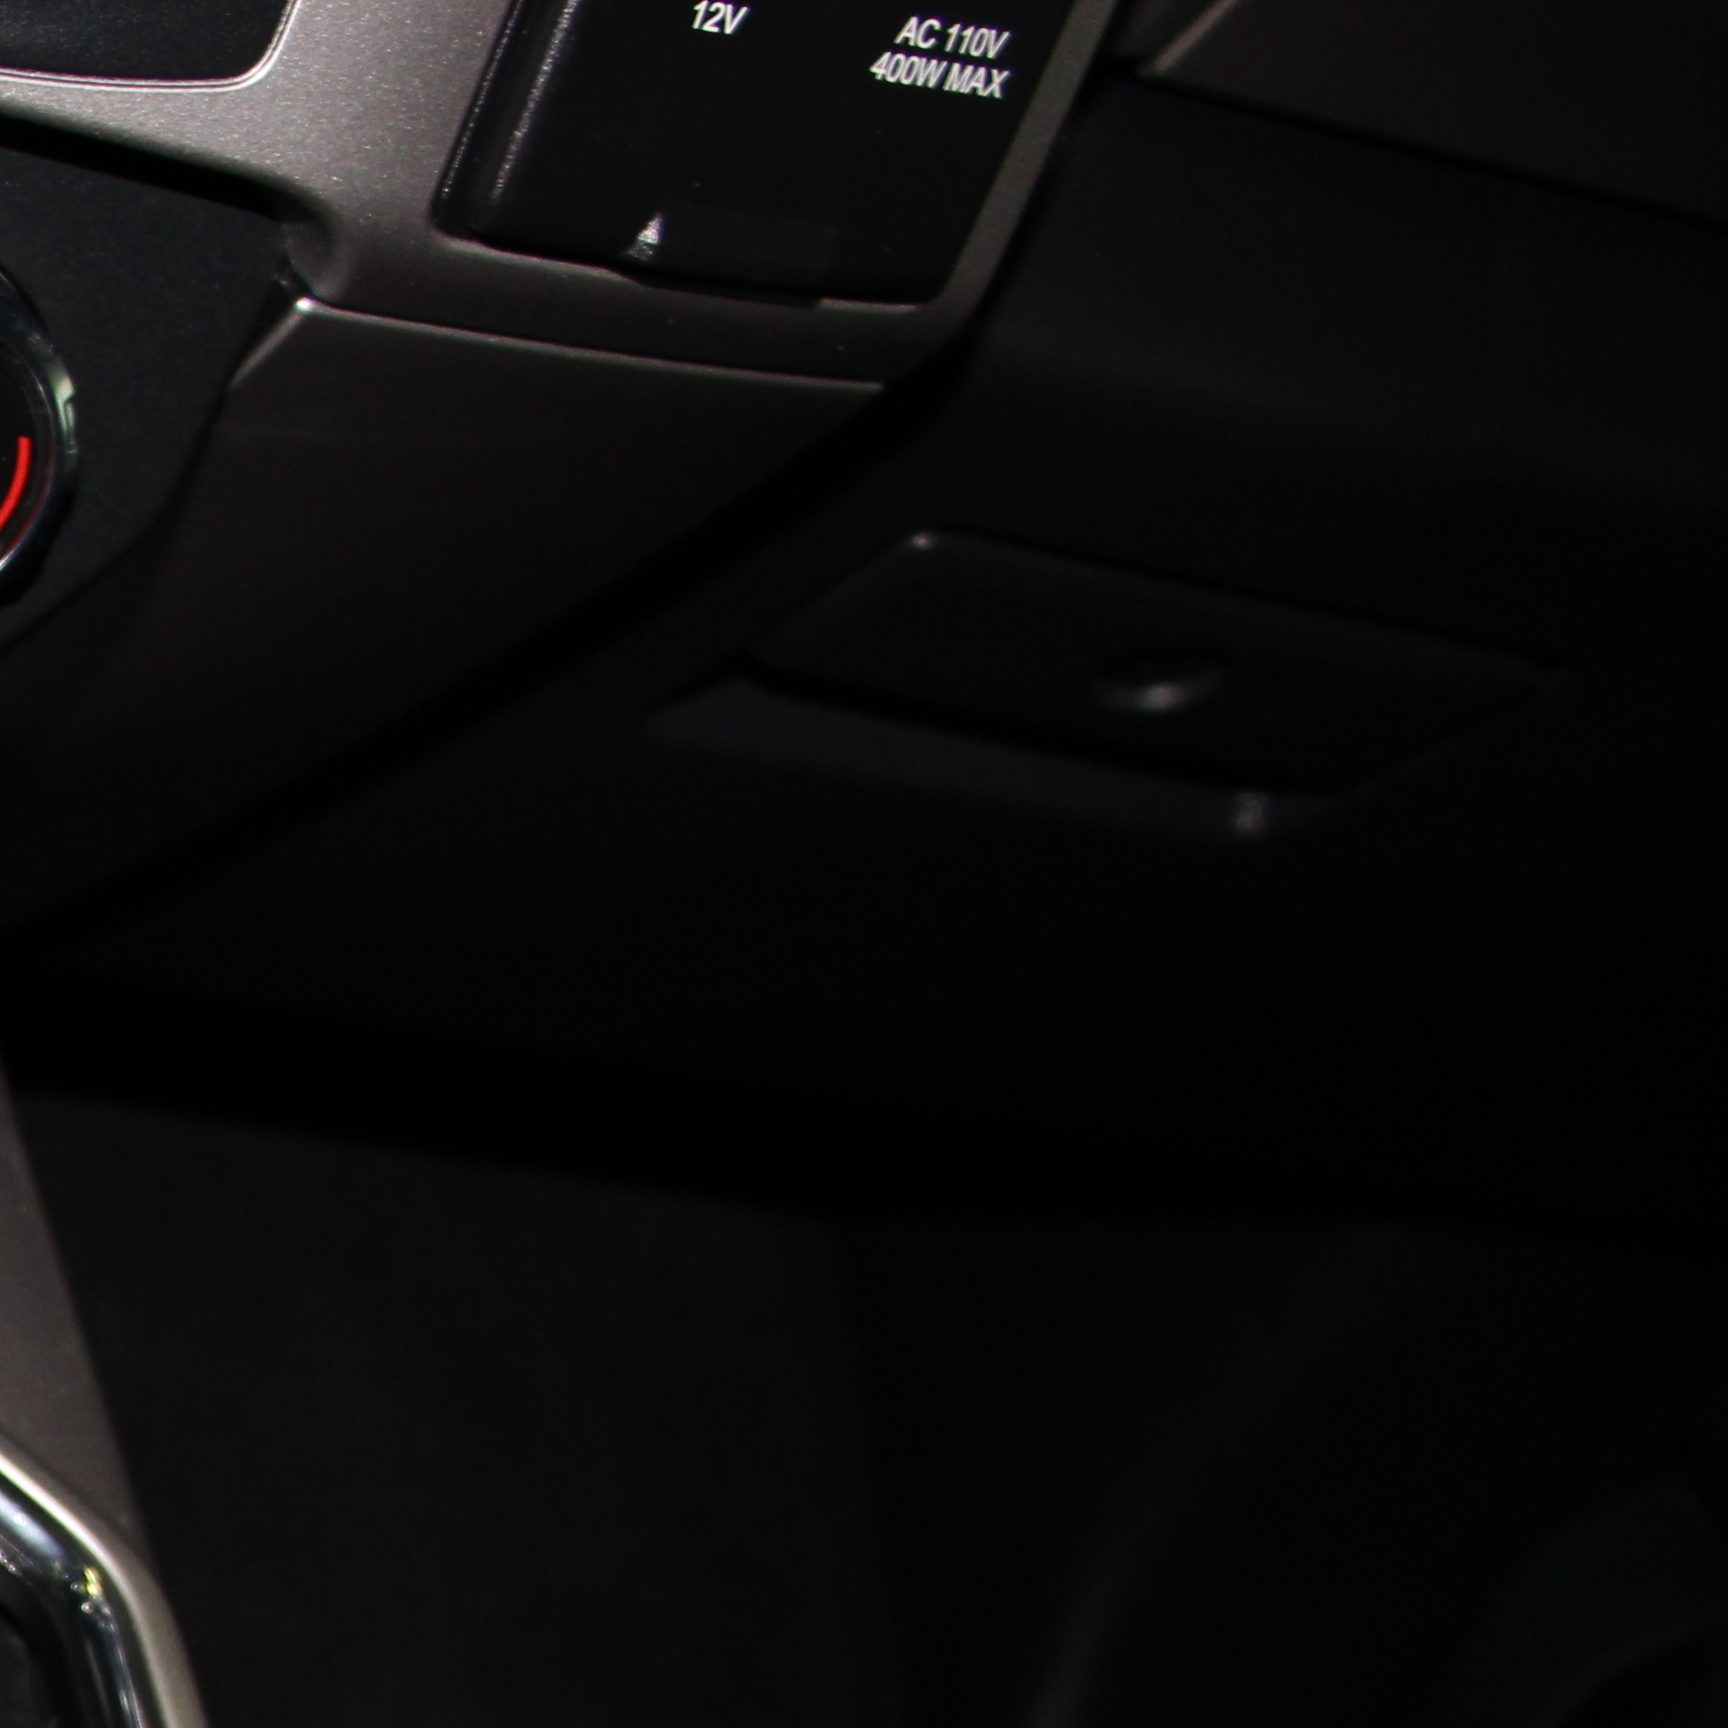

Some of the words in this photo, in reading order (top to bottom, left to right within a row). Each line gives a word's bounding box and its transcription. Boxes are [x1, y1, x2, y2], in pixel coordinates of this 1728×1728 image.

[693, 0, 748, 34] 12V
[895, 16, 940, 49] AC
[945, 23, 1010, 59] 110V
[870, 51, 947, 88] 400W
[944, 63, 1010, 98] MAX
